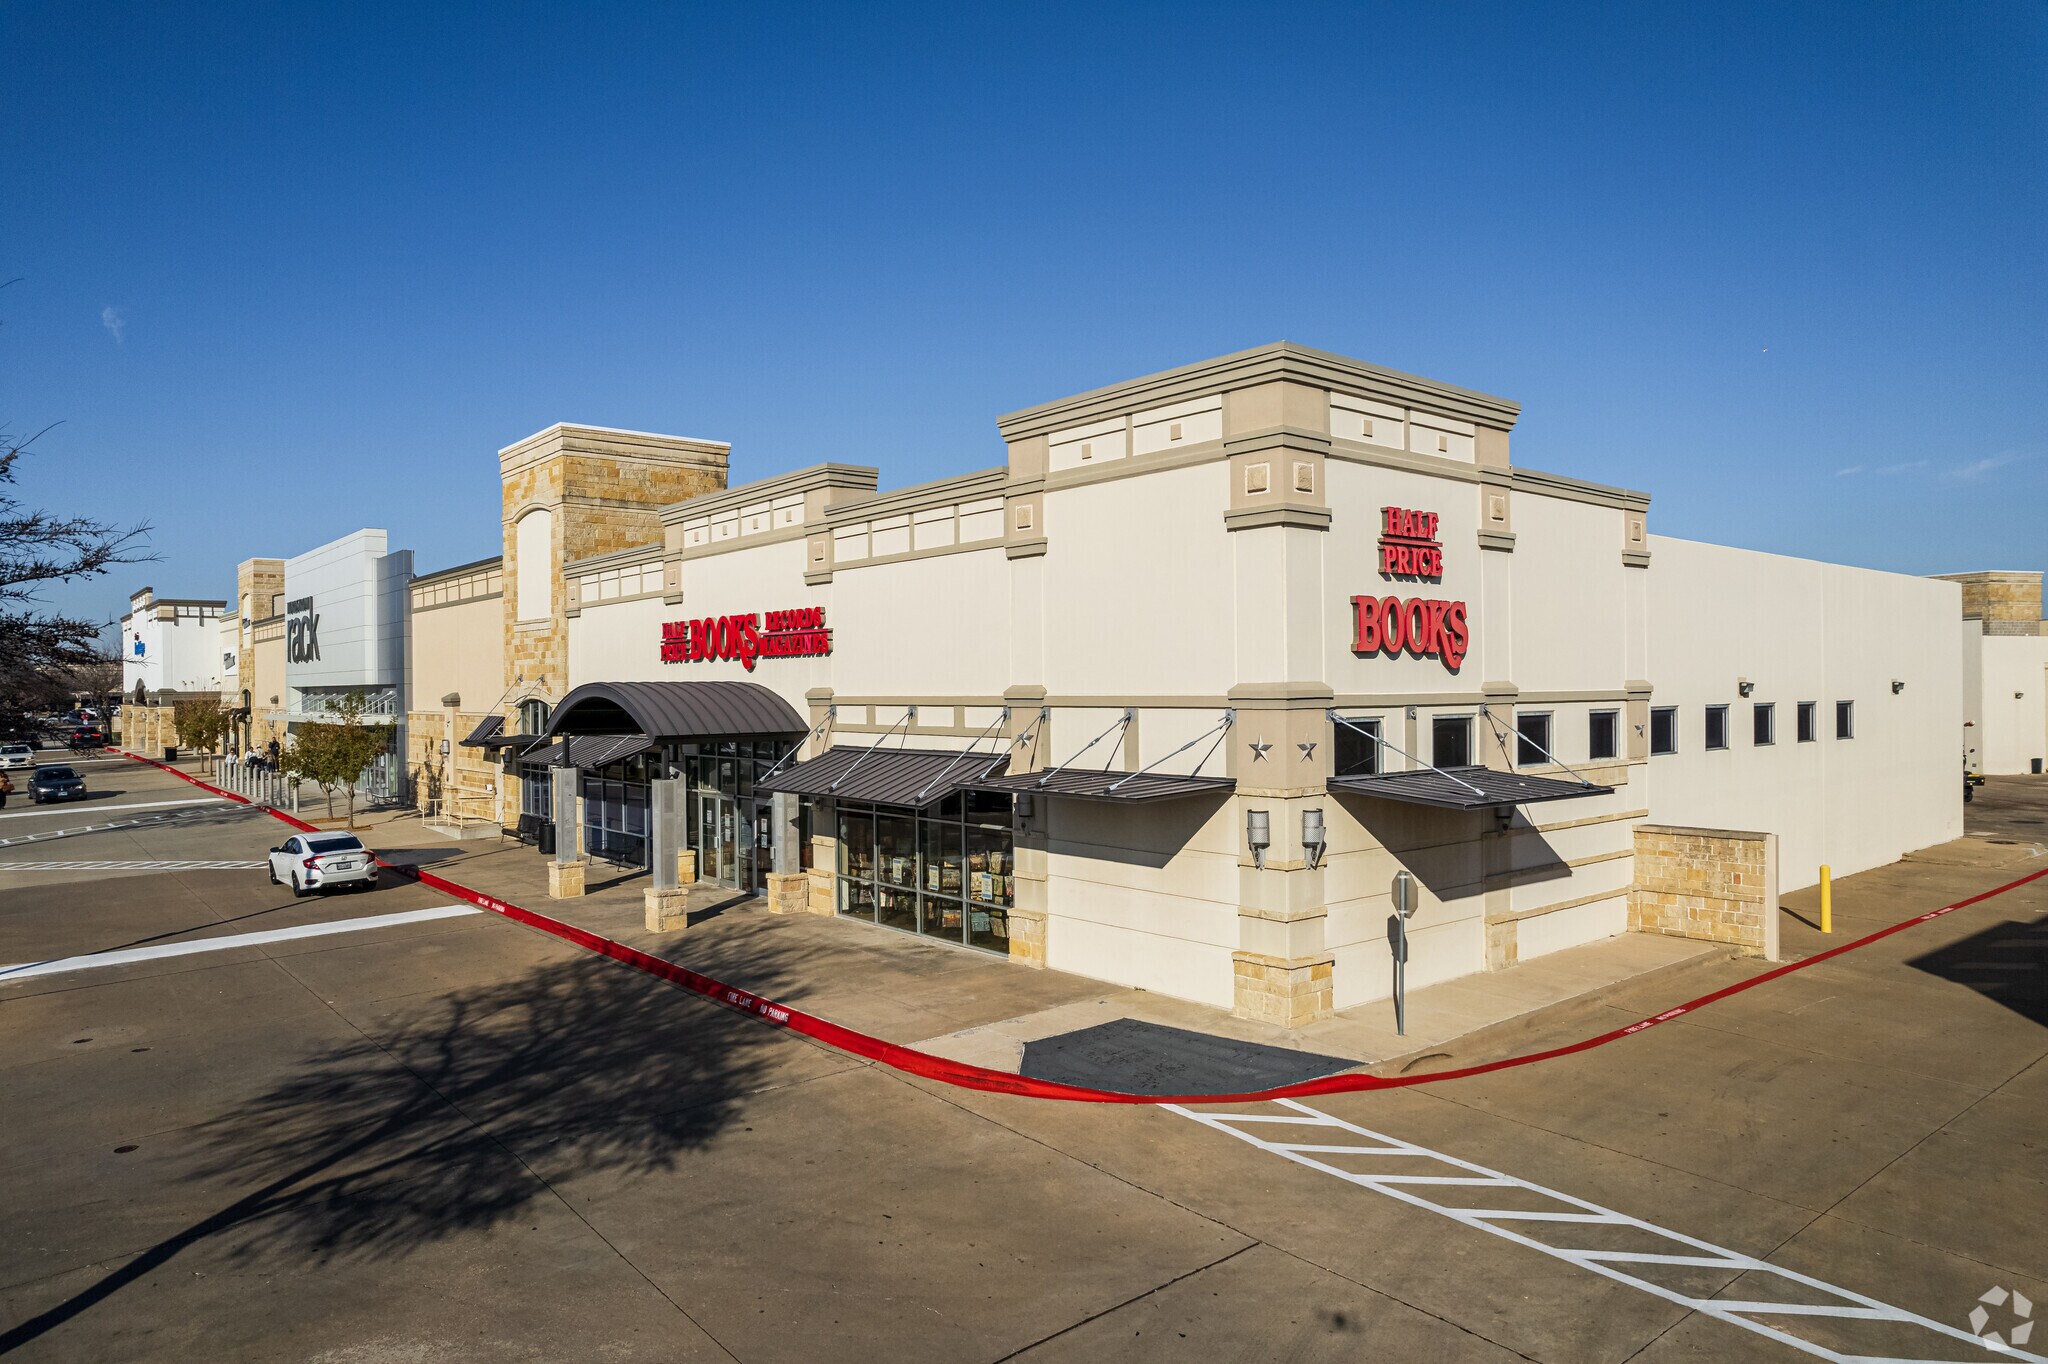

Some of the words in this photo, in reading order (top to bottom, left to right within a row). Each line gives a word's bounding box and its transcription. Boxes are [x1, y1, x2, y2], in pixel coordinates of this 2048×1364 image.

[1385, 506, 1439, 540] HALF
[1382, 545, 1443, 577] PRICE
[287, 595, 321, 664] rack
[765, 606, 823, 631] RECORDS
[1354, 595, 1469, 669] BOOKS
[689, 612, 760, 670] BOOKS
[759, 633, 829, 656] MAGAZINES
[760, 1003, 768, 1014] NO
[768, 1007, 789, 1022] PARKING
